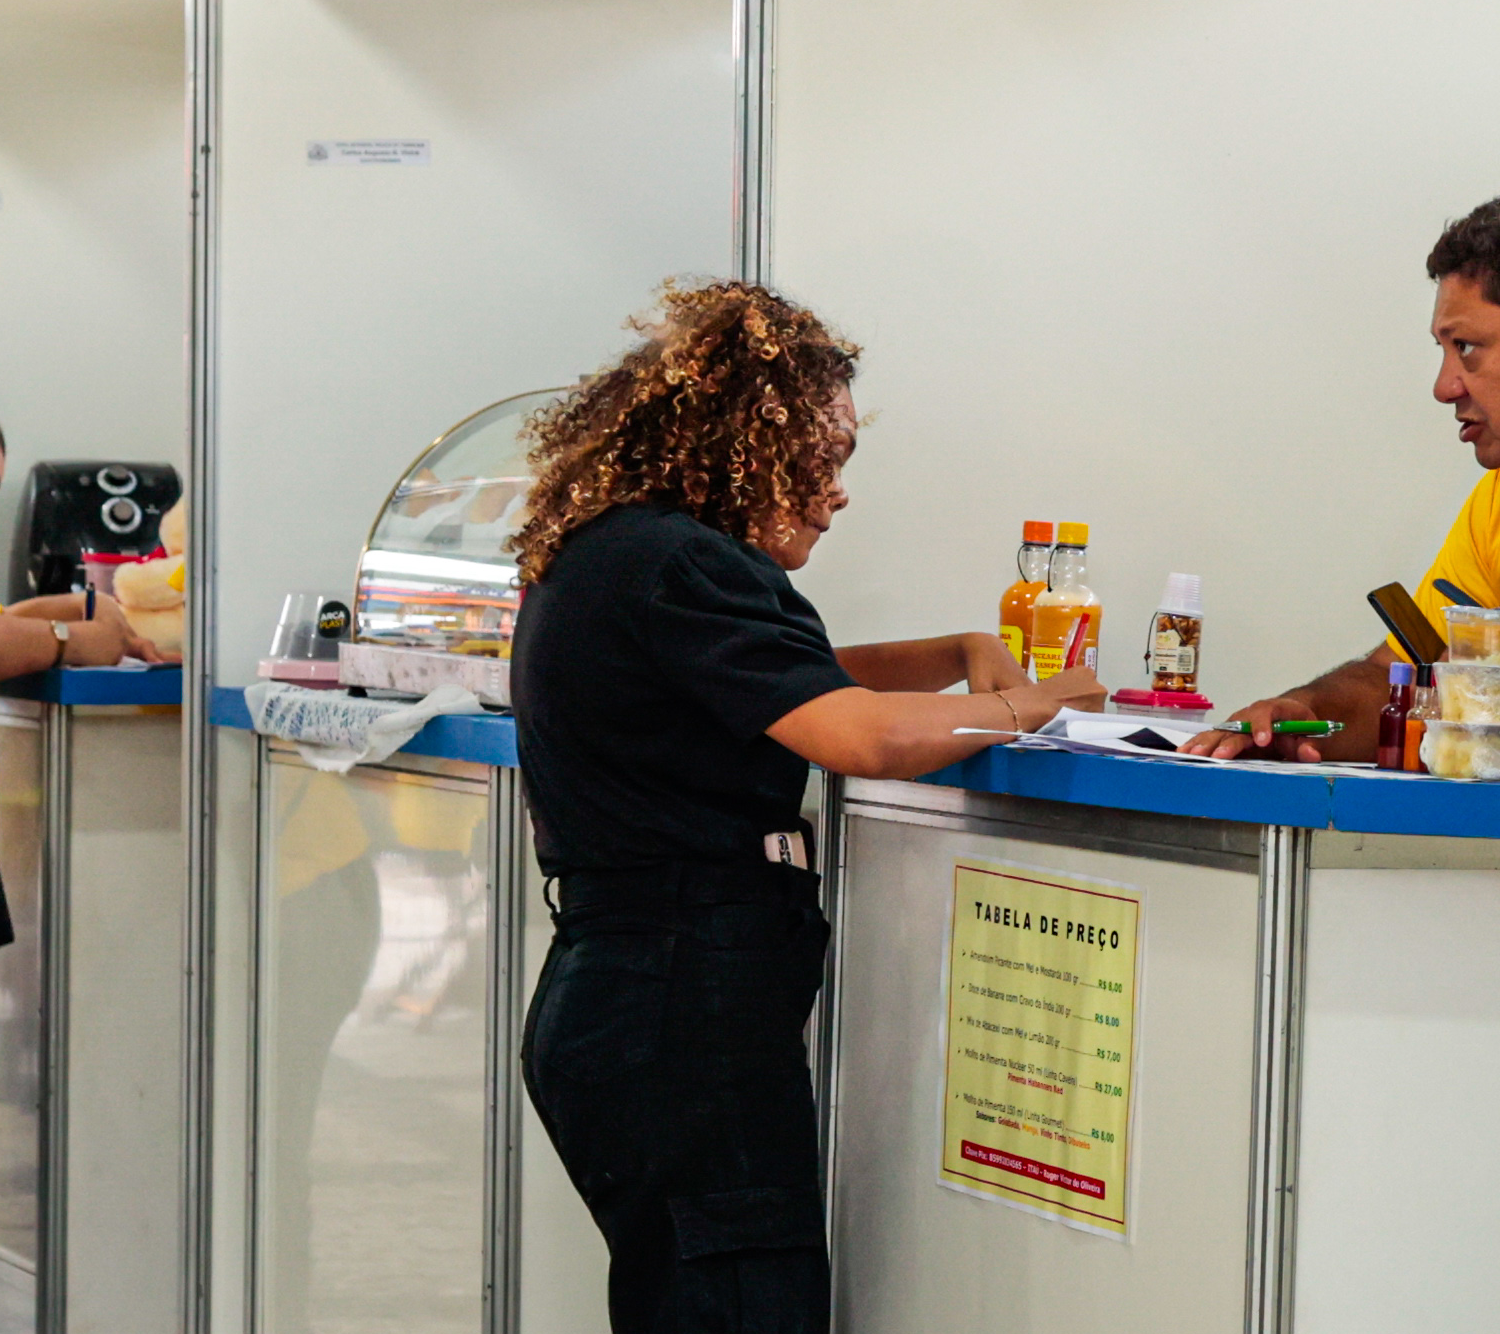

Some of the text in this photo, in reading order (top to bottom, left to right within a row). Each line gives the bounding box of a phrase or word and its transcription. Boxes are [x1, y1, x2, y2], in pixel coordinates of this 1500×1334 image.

[975, 901, 1119, 952] TABELA DE PREÇO
[1012, 962, 1025, 971] com
[1098, 979, 1106, 991] R$
[1005, 993, 1018, 1003] com
[1019, 995, 1034, 1008] Cravo
[1035, 998, 1042, 1008] da
[1095, 1013, 1103, 1024] R$
[1001, 1027, 1014, 1035] com
[1097, 1048, 1105, 1059] R$
[1106, 1050, 1121, 1063] 7,00
[986, 1053, 1007, 1067] Pimenta
[1027, 1063, 1035, 1074] 50
[1095, 1081, 1103, 1093] R$
[1104, 1084, 1122, 1097] 27,00
[1008, 1072, 1027, 1085] Pimenta
[984, 1098, 1006, 1113] Pimenta
[1091, 1128, 1099, 1139] R$
[1043, 1169, 1059, 1182] Roger
[1072, 1178, 1080, 1188] de
[1080, 1180, 1101, 1194] Oliveira
